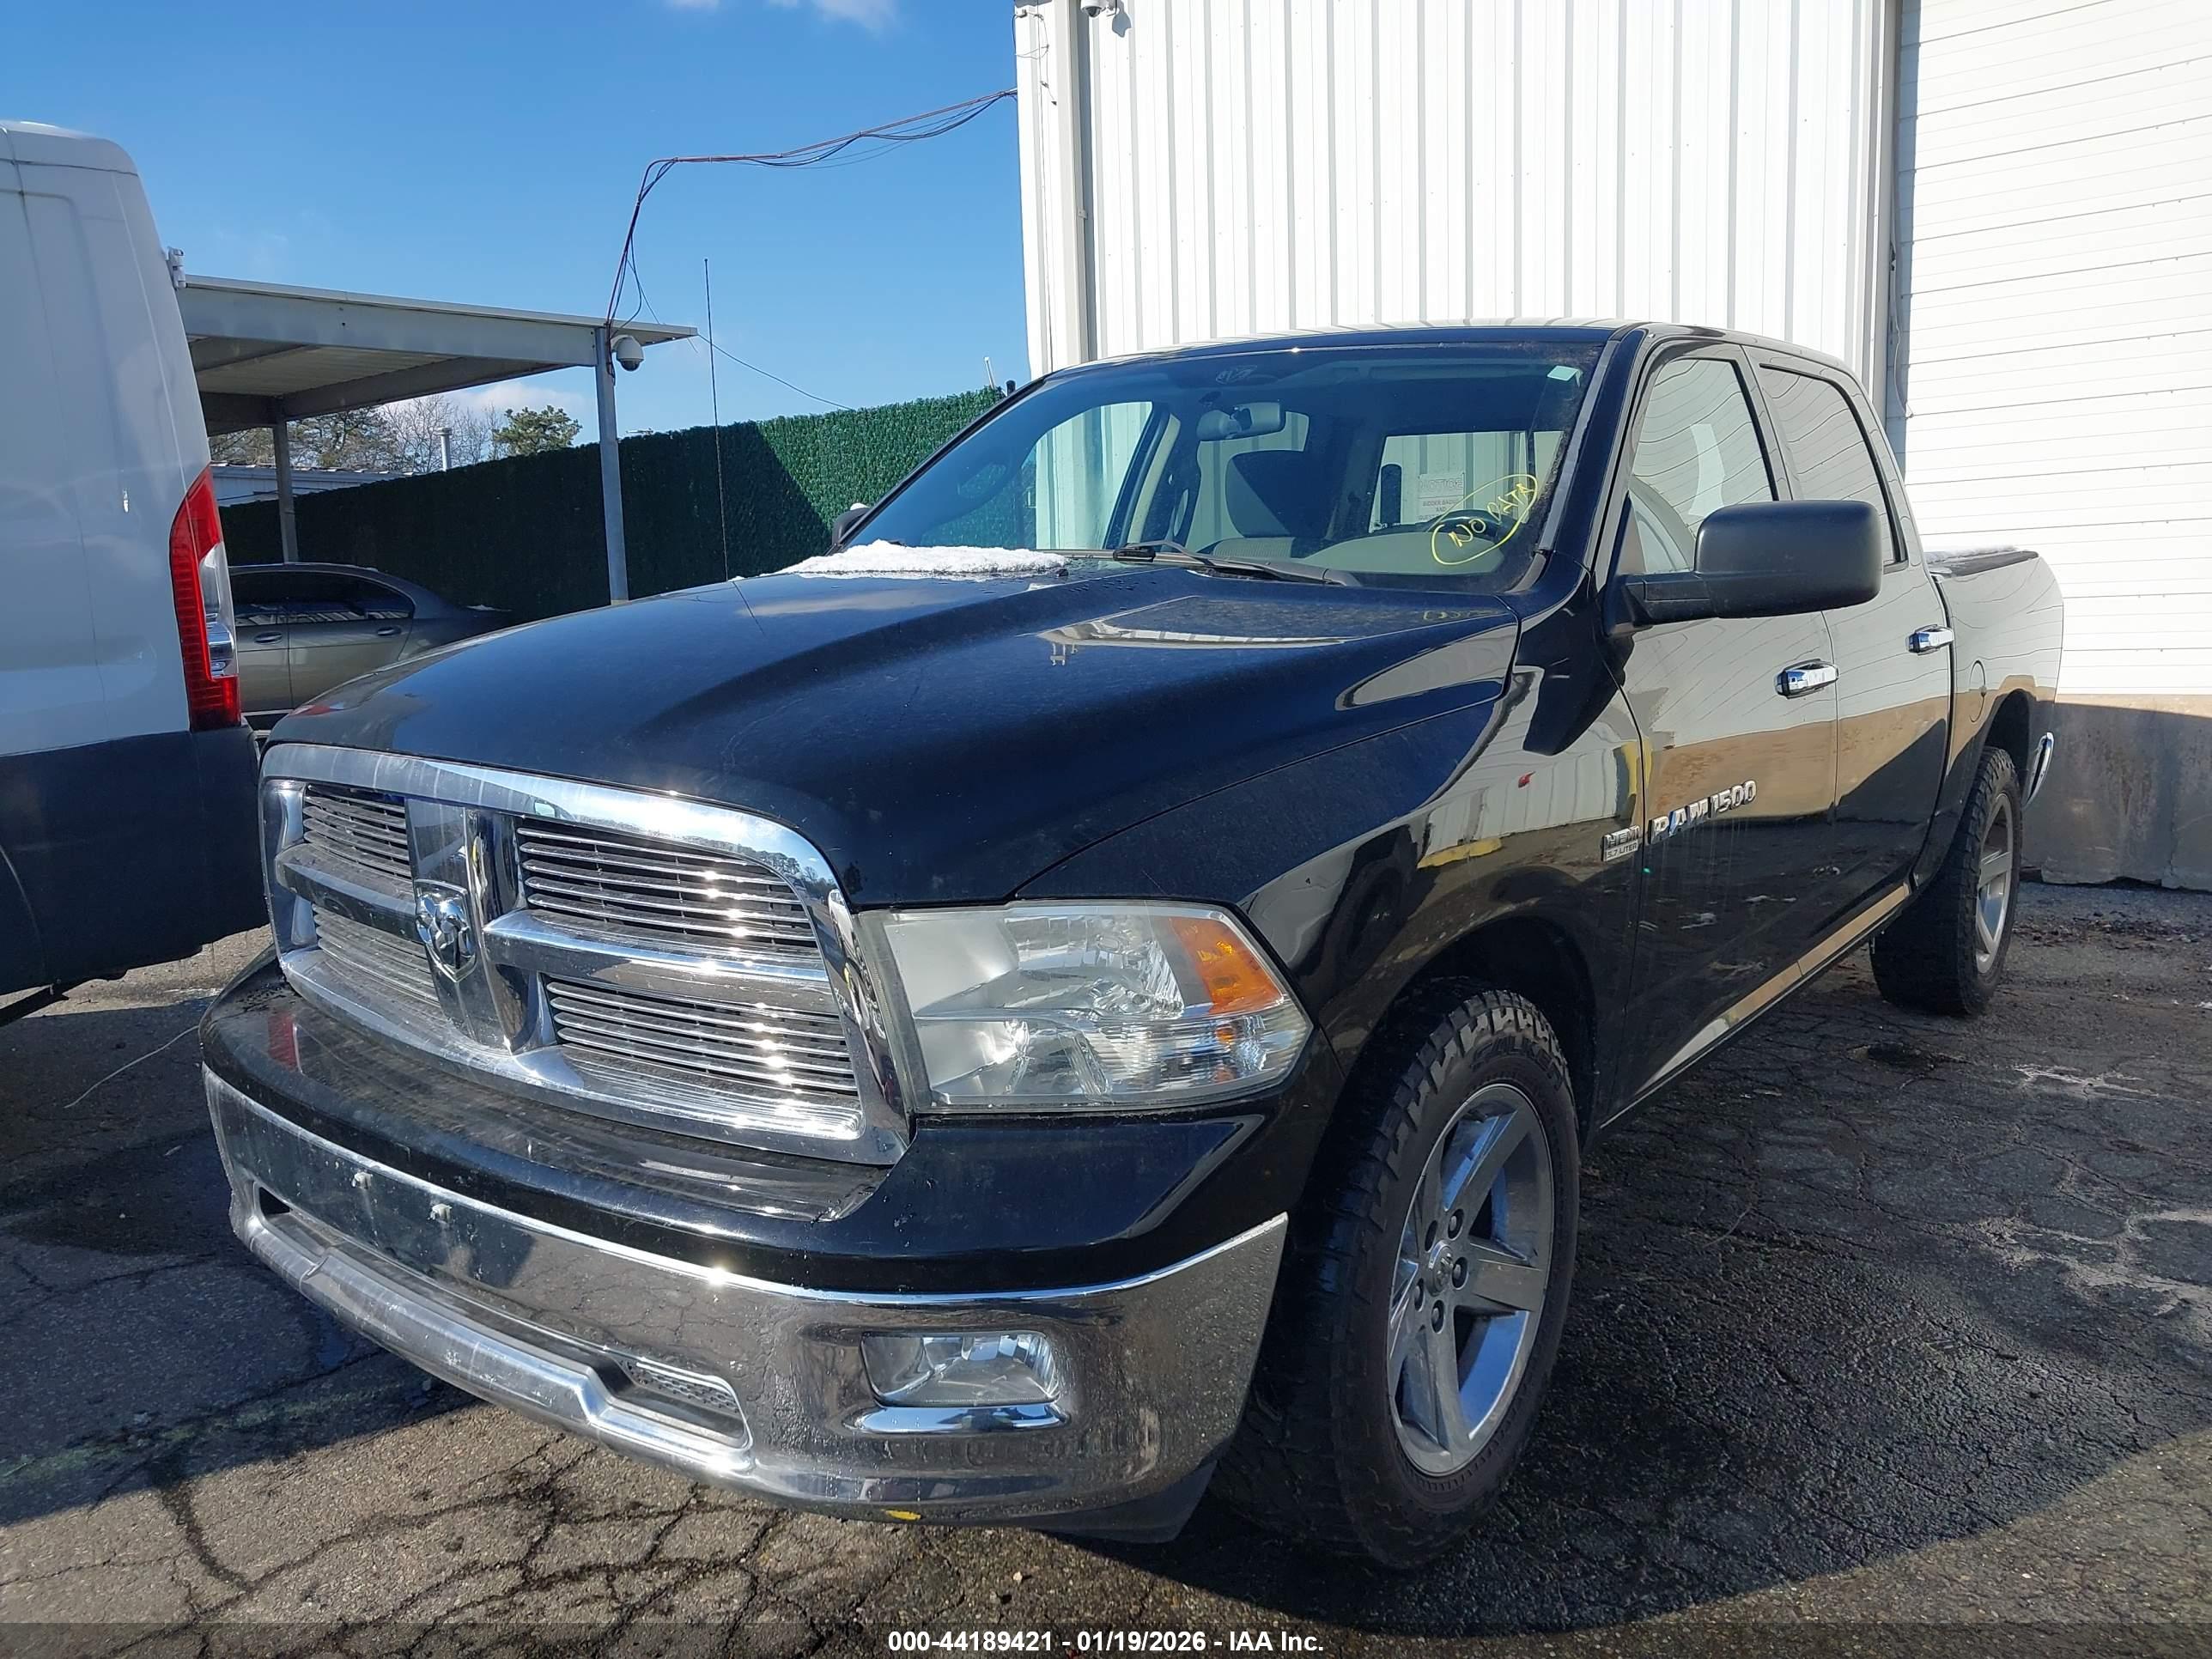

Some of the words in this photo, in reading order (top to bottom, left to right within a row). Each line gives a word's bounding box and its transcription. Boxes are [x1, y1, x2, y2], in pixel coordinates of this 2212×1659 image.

[1448, 518, 1486, 548] NO
[1486, 483, 1534, 526] DATA
[1648, 798, 1710, 845] RAM
[1709, 780, 1757, 817] 1500
[1605, 824, 1641, 848] HEMI
[1607, 849, 1618, 859] 5.7
[1619, 841, 1638, 855] LITER
